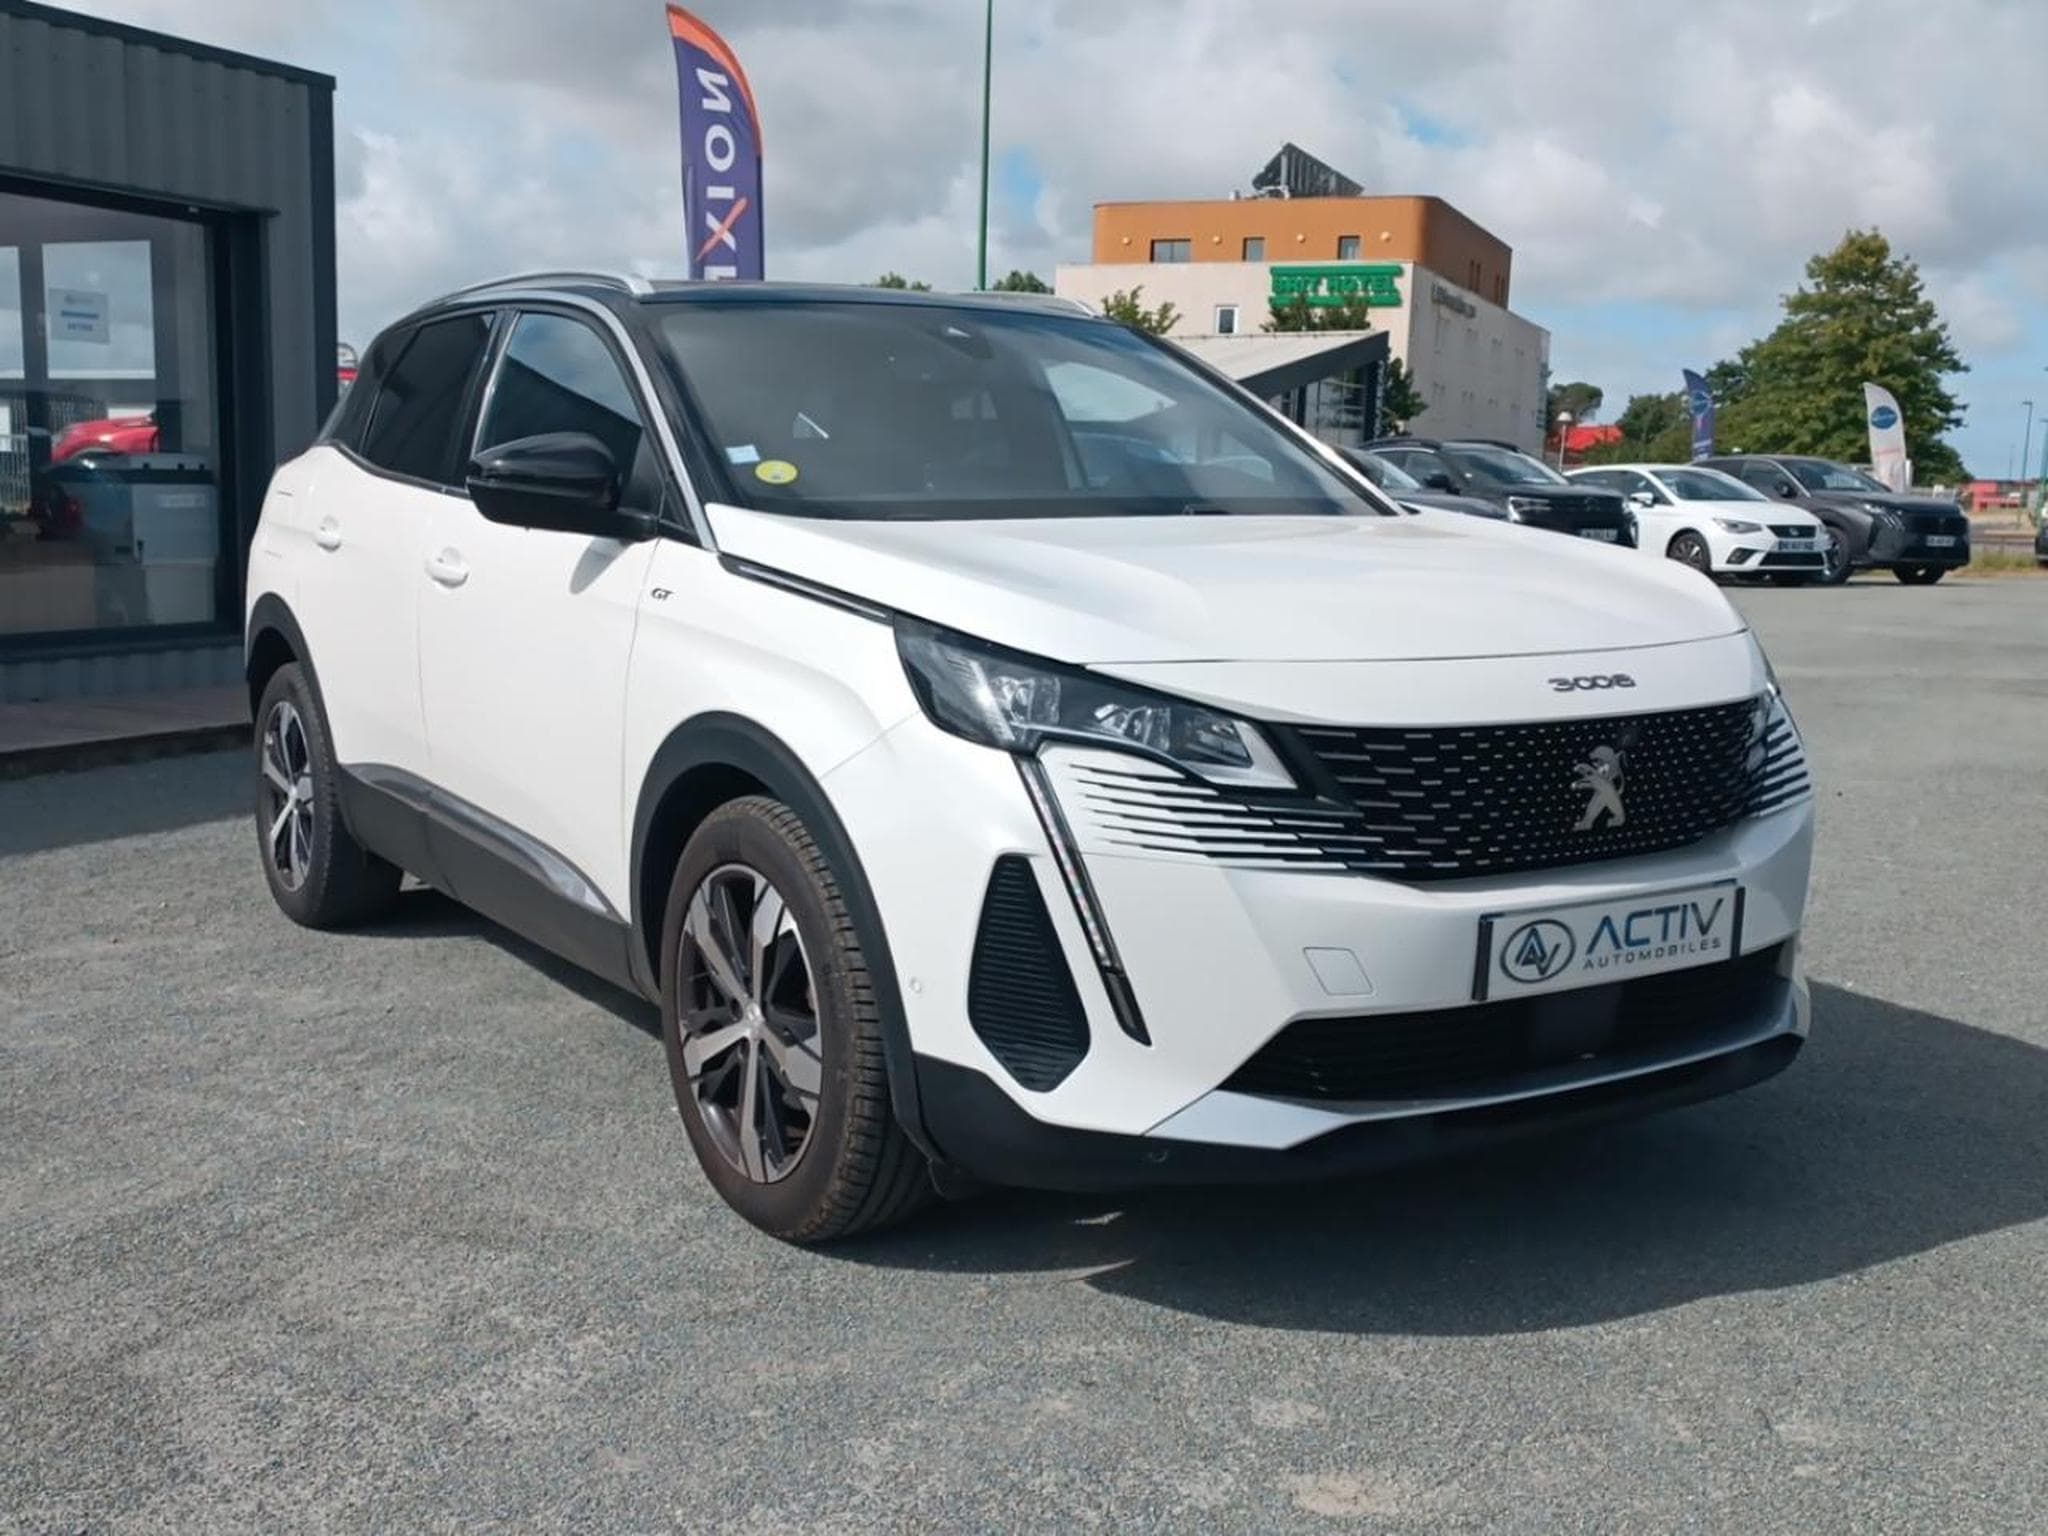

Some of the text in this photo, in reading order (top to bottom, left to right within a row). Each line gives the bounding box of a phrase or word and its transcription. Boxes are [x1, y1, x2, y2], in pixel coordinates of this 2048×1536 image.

[1326, 275, 1394, 297] HOTEL
[651, 587, 674, 601] GT
[1548, 673, 1636, 693] 3008
[1586, 898, 1724, 956] ACTIV
[1582, 937, 1721, 971] AUTOMOBILES
